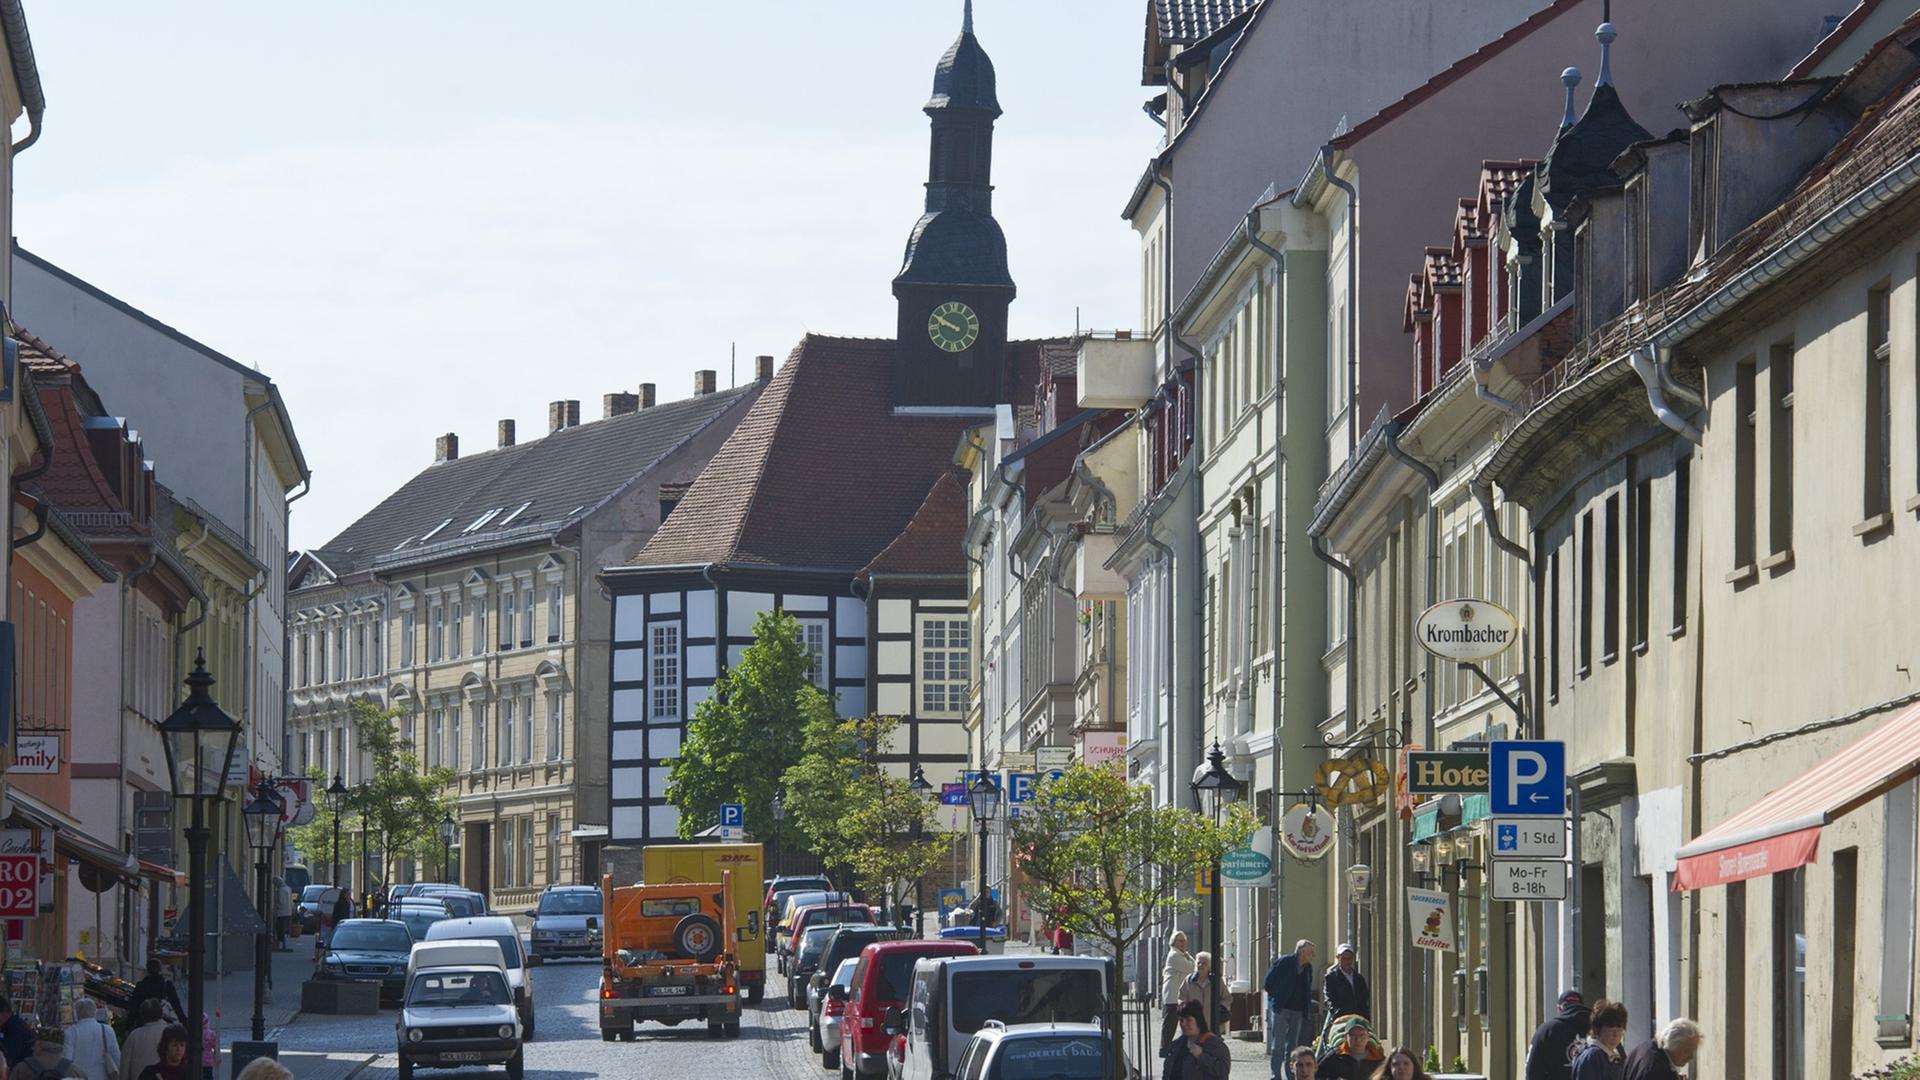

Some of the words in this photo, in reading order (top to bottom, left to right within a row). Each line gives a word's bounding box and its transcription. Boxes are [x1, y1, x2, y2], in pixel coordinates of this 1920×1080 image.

[1427, 623, 1509, 643] Krombacher
[16, 750, 56, 770] mily
[1416, 760, 1489, 786] Hote
[1508, 750, 1547, 806] P
[726, 807, 738, 824] P
[1522, 832, 1528, 844] 1
[1534, 832, 1559, 844] Std.
[1509, 867, 1548, 878] Mo-Fr
[1512, 882, 1546, 894] 8-18h
